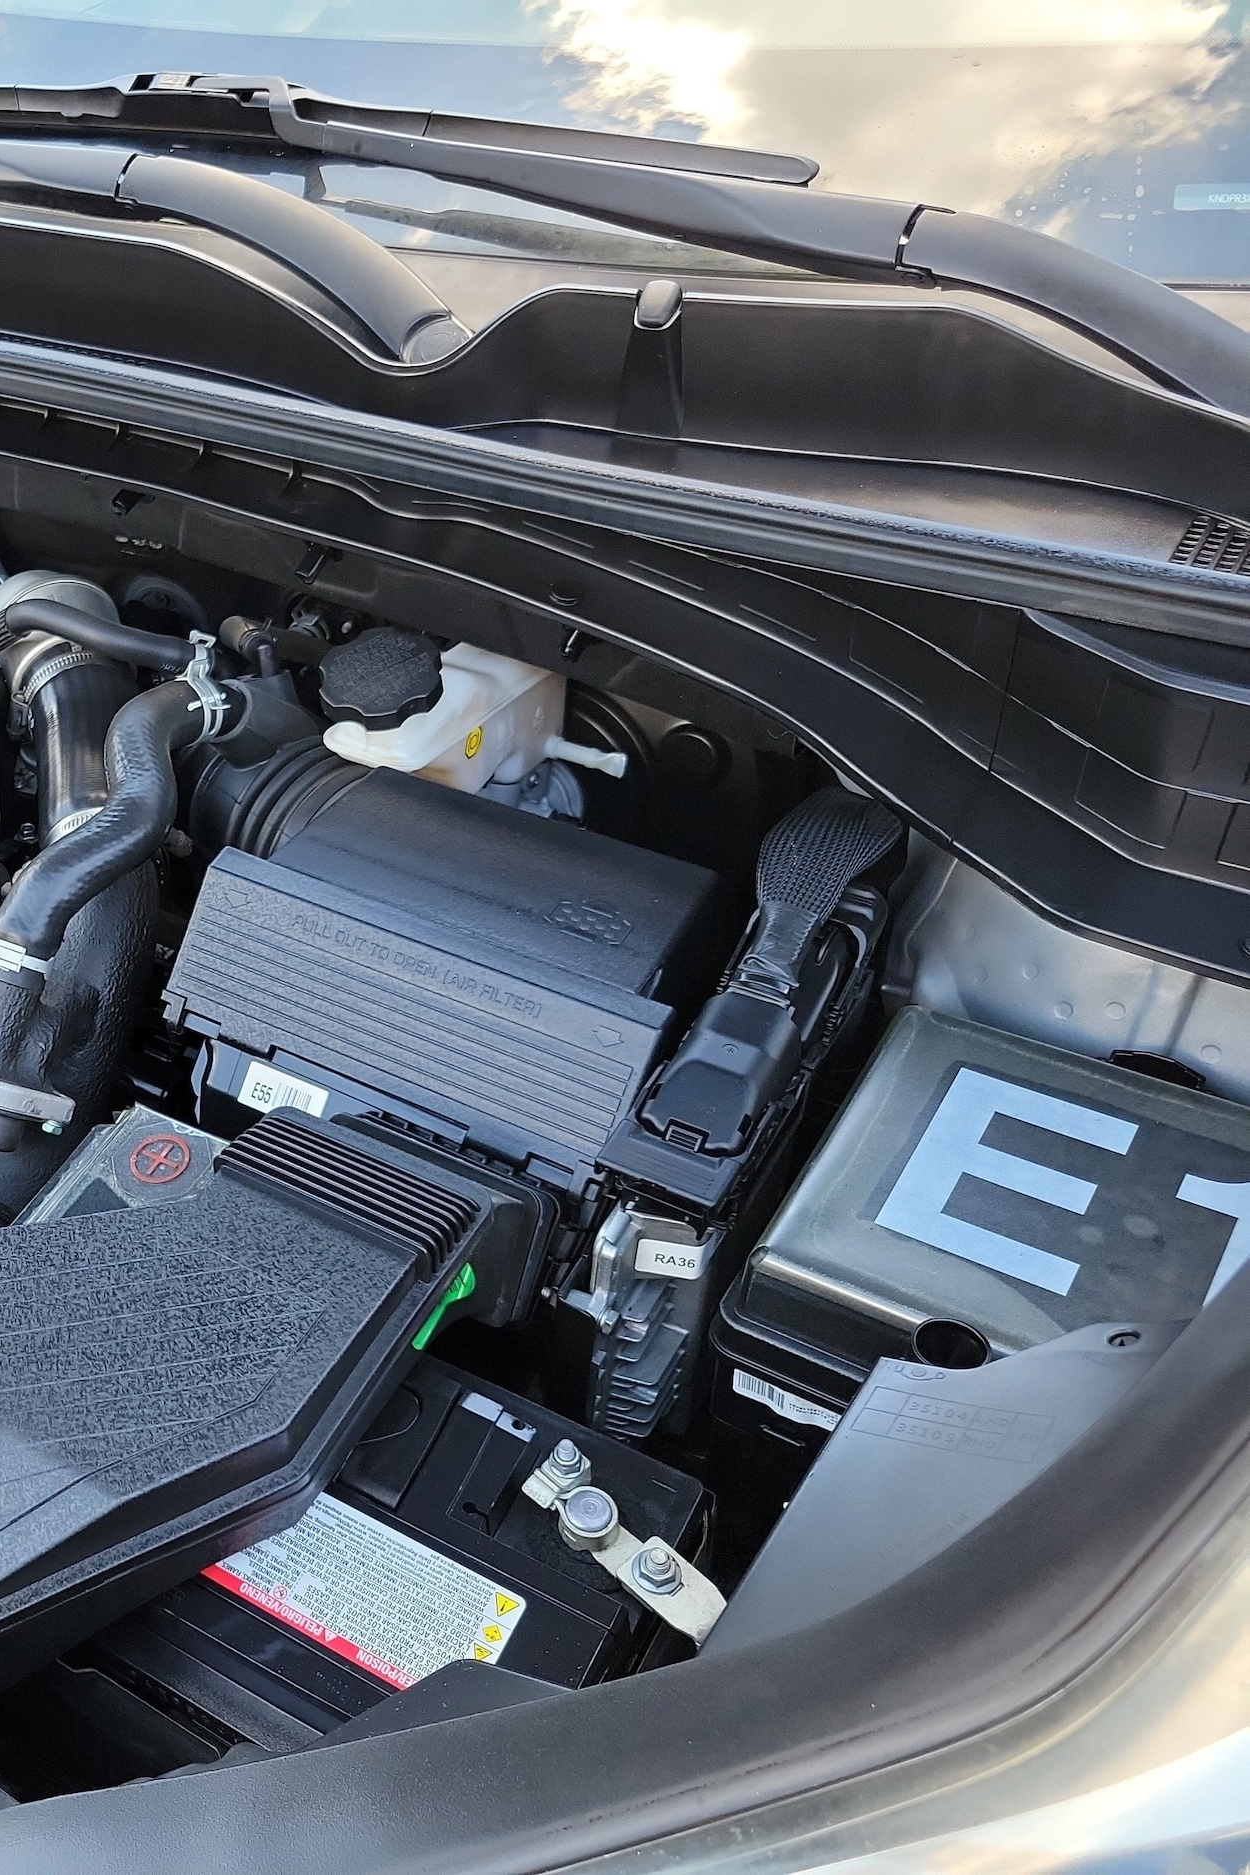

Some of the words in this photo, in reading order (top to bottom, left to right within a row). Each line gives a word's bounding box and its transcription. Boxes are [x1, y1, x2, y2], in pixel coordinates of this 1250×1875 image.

[293, 915, 329, 939] PULL
[335, 929, 366, 952] OUT
[370, 941, 390, 961] TO
[393, 950, 437, 978] OPEN
[442, 968, 477, 996] (AIR
[479, 984, 542, 1018] FILTER)
[250, 1082, 273, 1104] E55
[654, 1253, 696, 1269] RA36
[933, 1371, 946, 1380] D
[908, 1401, 968, 1421] 35104
[895, 1422, 956, 1443] 35105
[342, 1513, 358, 1524] manos
[305, 1530, 315, 1539] UN
[319, 1529, 341, 1545] ACUDA
[335, 1529, 347, 1539] after
[347, 1535, 363, 1547] hands
[284, 1536, 328, 1563] QUEMADURAS
[307, 1539, 324, 1552] HELP
[314, 1535, 348, 1557] CONSULTER
[362, 1543, 377, 1555] Wash
[255, 1555, 264, 1563] DE
[301, 1553, 314, 1565] DES
[323, 1548, 349, 1566] MEDICAL
[360, 1552, 374, 1563] CON
[415, 1558, 429, 1569] avoir
[290, 1567, 301, 1576] NO
[313, 1561, 325, 1570] OU
[332, 1563, 362, 1582] CEGUERA
[348, 1562, 361, 1572] GET
[393, 1560, 427, 1581] Reproductive
[249, 1569, 275, 1586] SMOKING
[288, 1574, 297, 1582] DE
[305, 1565, 330, 1582] SEVERE
[372, 1558, 426, 1591] INMEDIATAMENTE
[422, 1570, 442, 1583] Cancer
[443, 1573, 460, 1586] mains
[260, 1584, 271, 1593] NO
[280, 1578, 293, 1589] PAS
[329, 1578, 340, 1588] OR
[344, 1578, 354, 1587] LA
[361, 1578, 388, 1597] CAUSAR
[382, 1580, 399, 1593] WITH
[396, 1580, 415, 1594] L'EAU
[426, 1578, 436, 1587] and
[459, 1582, 468, 1590] les
[303, 1590, 314, 1600] OU
[305, 1583, 330, 1601] GASES
[338, 1583, 375, 1607] BLINDNESS
[353, 1583, 379, 1600] CAUSER
[424, 1587, 442, 1600] OJOS
[436, 1583, 456, 1597] Cancer
[467, 1587, 482, 1598] laver
[330, 1597, 345, 1609] LOS
[378, 1597, 396, 1610] PEUT
[386, 1592, 409, 1608] PUEDE
[399, 1589, 439, 1615] IMMEDIATELY
[419, 1592, 437, 1606] YEUX
[441, 1596, 455, 1607] LOS
[481, 1594, 490, 1602] Se
[237, 1581, 323, 1636] PELIGRO/VENENO
[313, 1596, 341, 1615] BLESSER
[374, 1603, 397, 1619] CAUSE
[436, 1601, 449, 1612] LES
[453, 1602, 484, 1623] ENJUAGE
[309, 1611, 324, 1623] CAN
[328, 1613, 339, 1623] SE
[341, 1611, 370, 1631] PEUVENT
[394, 1605, 441, 1635] SULFURIQUE
[396, 1615, 411, 1627] CAN
[408, 1604, 449, 1631] SULFURICO
[438, 1611, 455, 1624] EYES
[447, 1608, 471, 1624] RINSER
[323, 1619, 348, 1637] GASES
[366, 1617, 381, 1630] LOS
[380, 1617, 408, 1636] CAUSAR
[410, 1623, 431, 1638] ACID
[455, 1621, 477, 1636] FLUSH
[470, 1620, 480, 1629] SE
[366, 1634, 377, 1644] OR
[369, 1628, 408, 1653] EXPLOSIFS
[381, 1626, 415, 1648] PROTEJA
[407, 1632, 435, 1651] PUEDEN
[439, 1631, 470, 1652] L'ACIDE
[347, 1633, 387, 1659] EXPLOSIVE
[376, 1640, 413, 1664] BLINDNESS
[429, 1634, 467, 1659] SULFURIC
[407, 1649, 424, 1663] GAZ
[419, 1647, 447, 1666] VEUGLE.
[435, 1648, 454, 1662] IVOS
[386, 1655, 406, 1670] EYES
[412, 1661, 432, 1675] AUSE
[424, 1659, 439, 1671] LES
[406, 1666, 423, 1680] IELD
